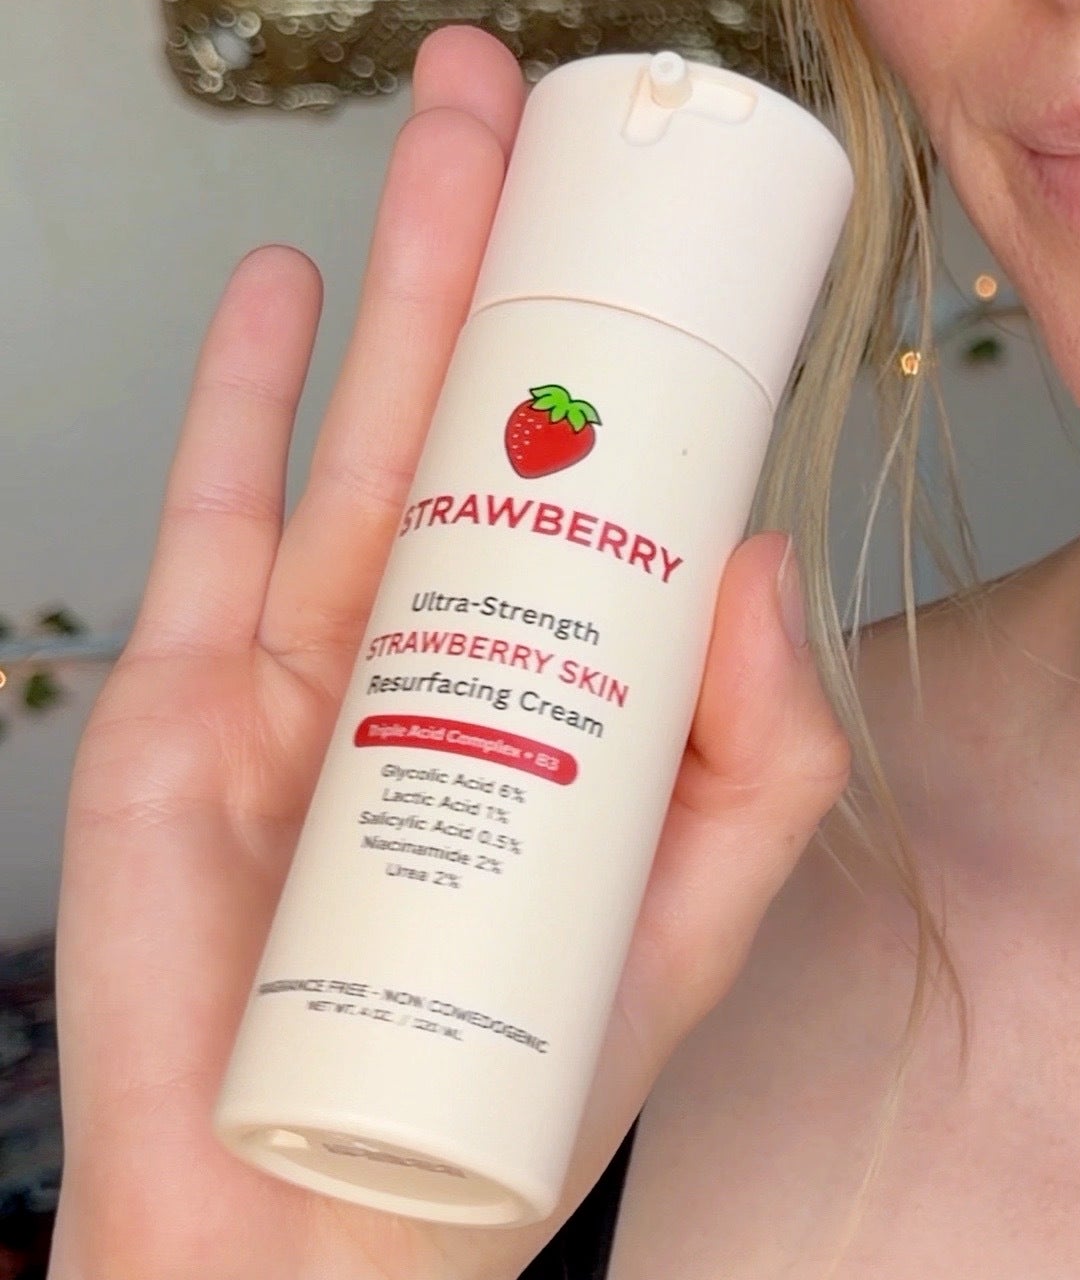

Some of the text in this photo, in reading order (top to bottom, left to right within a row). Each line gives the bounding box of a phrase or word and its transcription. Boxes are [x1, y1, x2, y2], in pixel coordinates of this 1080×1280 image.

[400, 494, 684, 584] STRAWBERRY
[411, 591, 600, 645] Ultra-Strength
[366, 631, 630, 707] STRAWBERRY SKIN
[367, 672, 604, 738] Resurfacing Cream
[407, 724, 446, 741] Acid
[447, 729, 521, 759] Complex
[380, 764, 449, 783] Glycolic
[453, 773, 496, 793] Acid
[382, 788, 435, 806] Lactic
[439, 796, 481, 816] Acid
[358, 810, 523, 855] Salicylic Acid 0.5%
[361, 835, 504, 874] Niacinamide 2%
[385, 863, 463, 889] Urea 2%
